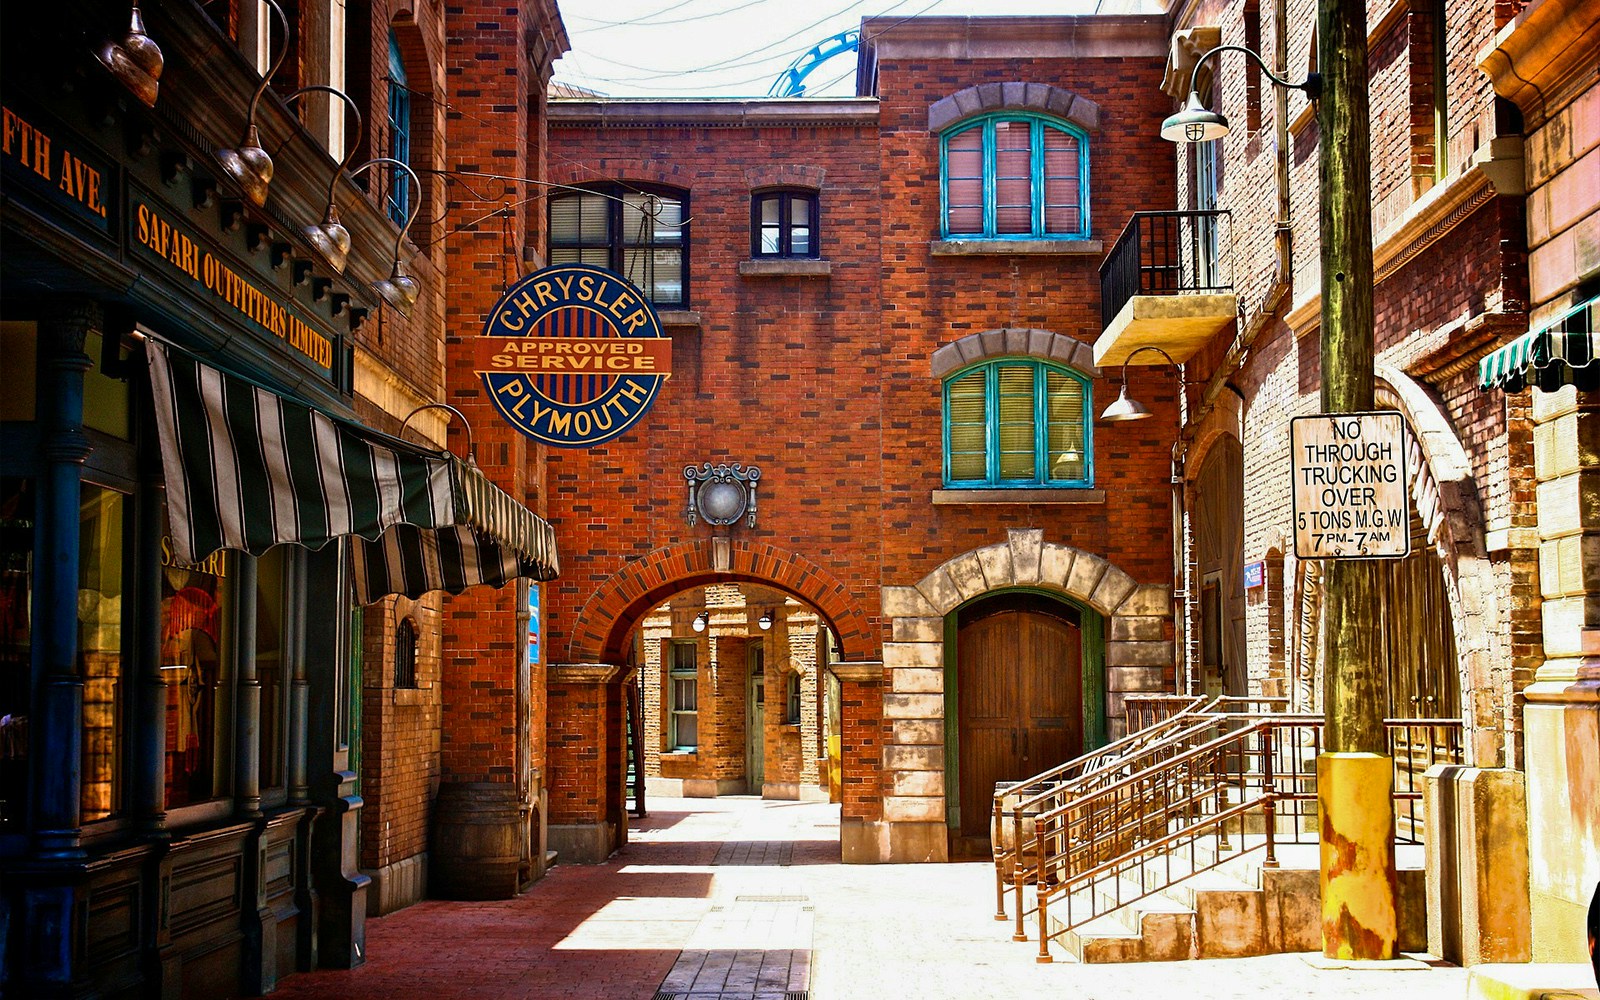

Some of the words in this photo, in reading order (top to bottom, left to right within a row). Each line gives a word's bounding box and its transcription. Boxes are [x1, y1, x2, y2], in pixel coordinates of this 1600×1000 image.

[59, 150, 106, 218] AVE.
[137, 204, 200, 281] SAFARI
[203, 252, 287, 339] OUTFITTERS
[289, 313, 333, 370] LIMITED
[500, 275, 648, 335] CHRYSLER
[502, 342, 644, 355] APPROVED
[491, 355, 655, 370] SERVICE
[497, 378, 648, 437] PLYMOUTH
[1332, 421, 1361, 440] NO
[1305, 442, 1392, 463] THROUGH
[1301, 464, 1397, 485] TRUCKING
[1321, 487, 1377, 507] OVER
[1298, 512, 1307, 530] 5
[1310, 510, 1352, 530] TONS
[1355, 508, 1402, 529] M.G.W
